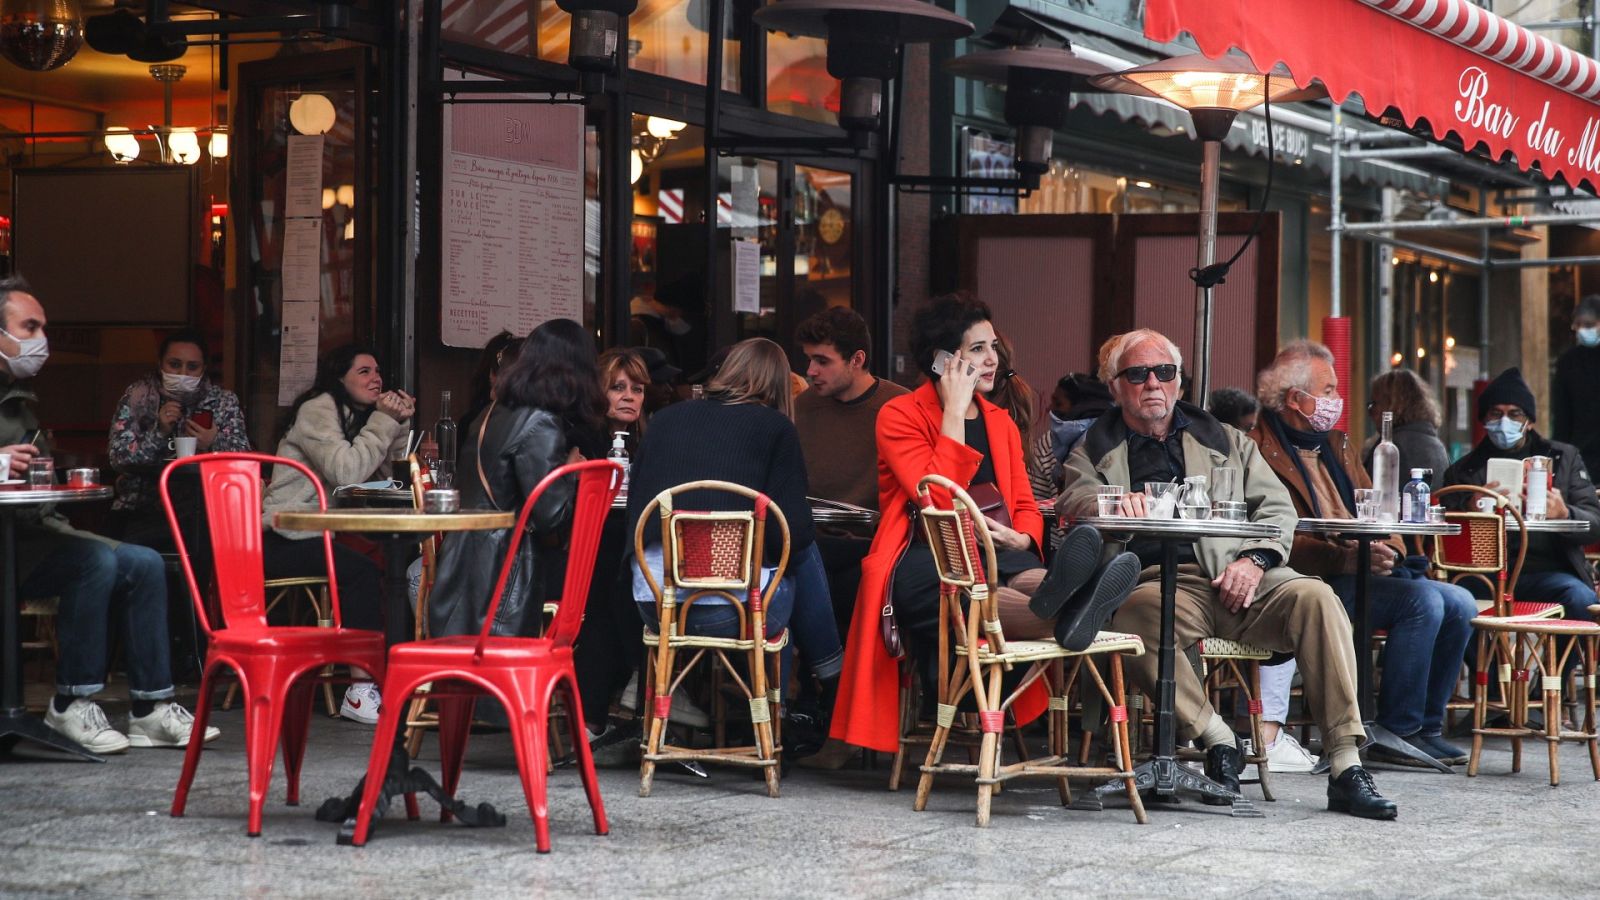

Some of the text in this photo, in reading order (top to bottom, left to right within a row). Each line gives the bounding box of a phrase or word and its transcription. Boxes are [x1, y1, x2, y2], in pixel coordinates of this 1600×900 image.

[1455, 66, 1519, 138] Bar
[1527, 101, 1565, 157] du
[1252, 119, 1285, 151] DELCE
[450, 189, 479, 200] SUR LE
[450, 198, 479, 210] POUCE
[450, 309, 478, 318] RECETTES
